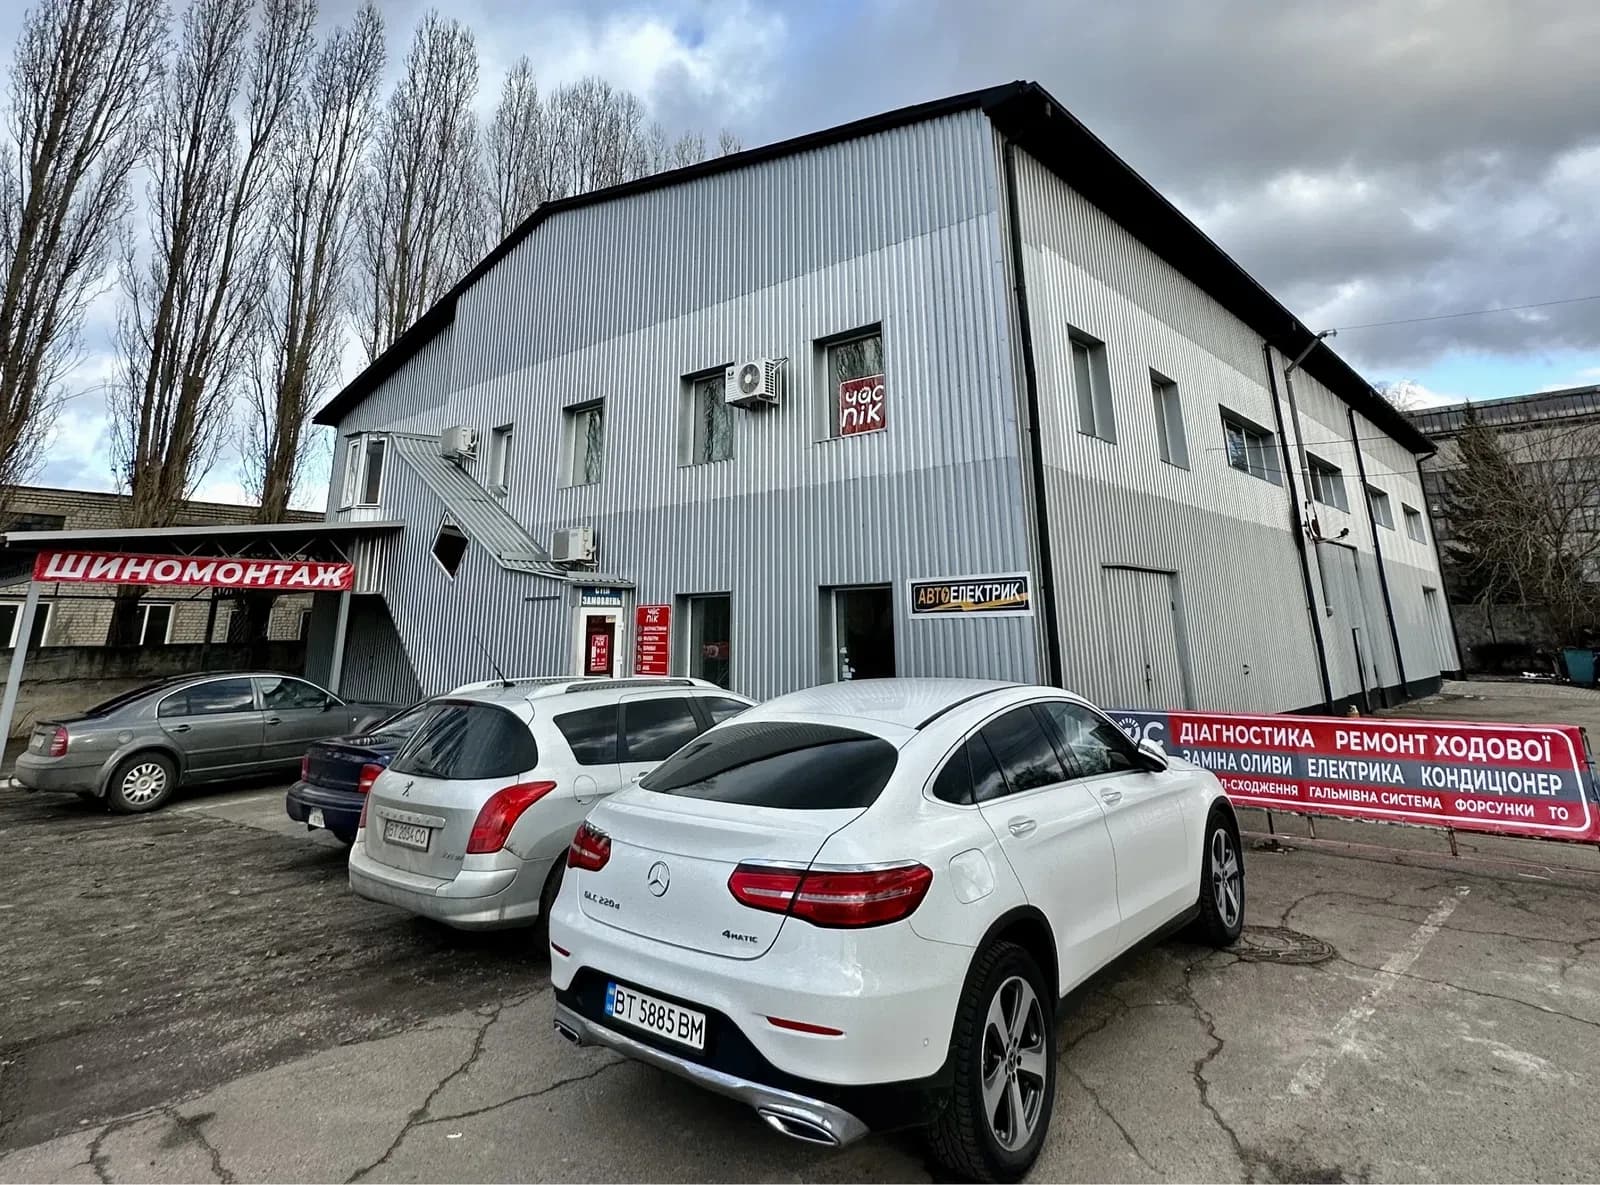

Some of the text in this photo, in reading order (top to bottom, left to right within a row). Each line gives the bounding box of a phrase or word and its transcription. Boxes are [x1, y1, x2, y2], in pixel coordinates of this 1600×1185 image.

[44, 553, 344, 587] ШИНОМОНТАЖ
[918, 583, 1020, 605] АВТОЕЛЕКТРИК
[1179, 722, 1552, 762] ДІАГНОСТИКА РЕМОНТ ХОДОВОЇ
[1183, 750, 1562, 796] ЗАМІНА ОЛИВИ ЕЛЕКТРИКА КОНДИЦІОНЕР
[1221, 778, 1569, 821] Л-СХОДЖЕННЯ ГАЛЬМІВНА СИСТЕМА ФОРСУНКИ ТО
[721, 929, 759, 944] 4MATIC
[614, 989, 704, 1044] BT 5885 BM
